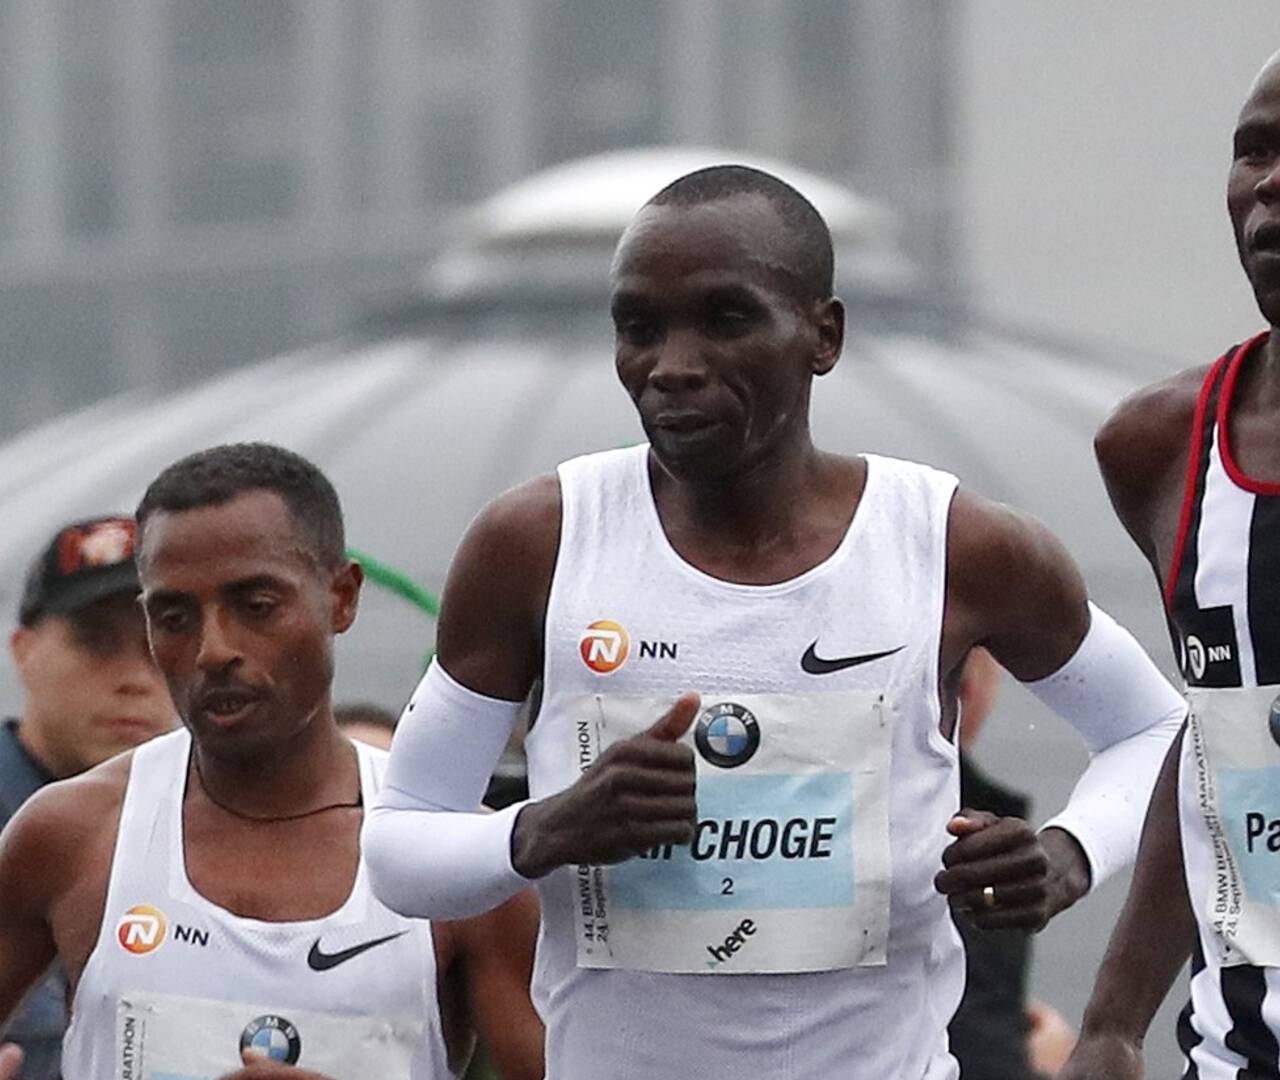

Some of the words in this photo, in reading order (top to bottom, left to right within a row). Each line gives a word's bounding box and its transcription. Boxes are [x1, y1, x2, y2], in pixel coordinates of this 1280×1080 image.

[639, 640, 678, 659] NN
[1208, 645, 1231, 661] NN
[639, 818, 837, 860] CHOGE
[722, 878, 734, 896] 2
[174, 925, 210, 947] NN
[707, 918, 757, 961] here
